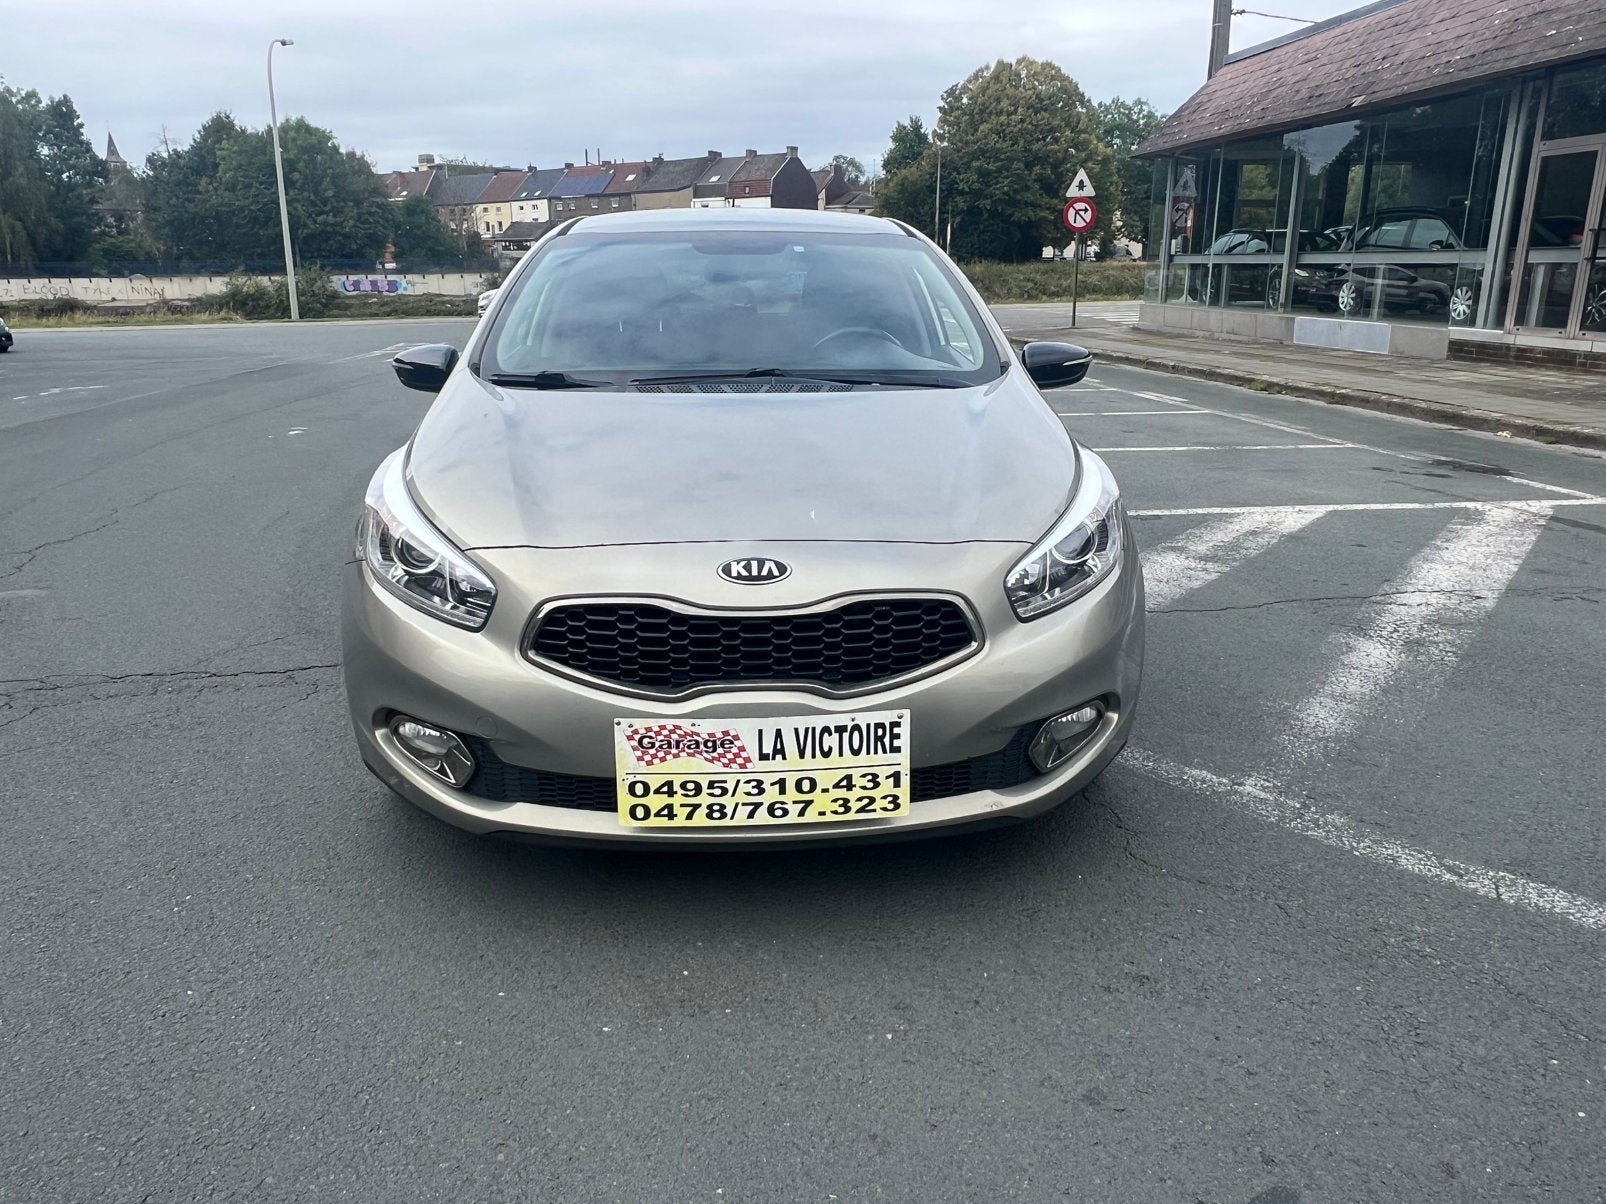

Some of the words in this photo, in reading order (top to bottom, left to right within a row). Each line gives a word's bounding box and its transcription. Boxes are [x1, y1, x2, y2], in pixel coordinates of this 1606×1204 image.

[730, 560, 780, 577] KIA
[637, 734, 736, 755] Garage
[757, 728, 787, 762] LA
[793, 720, 902, 760] VICTOIRE
[627, 770, 902, 799] 0495/310.431
[628, 793, 902, 822] 0478/767.323
